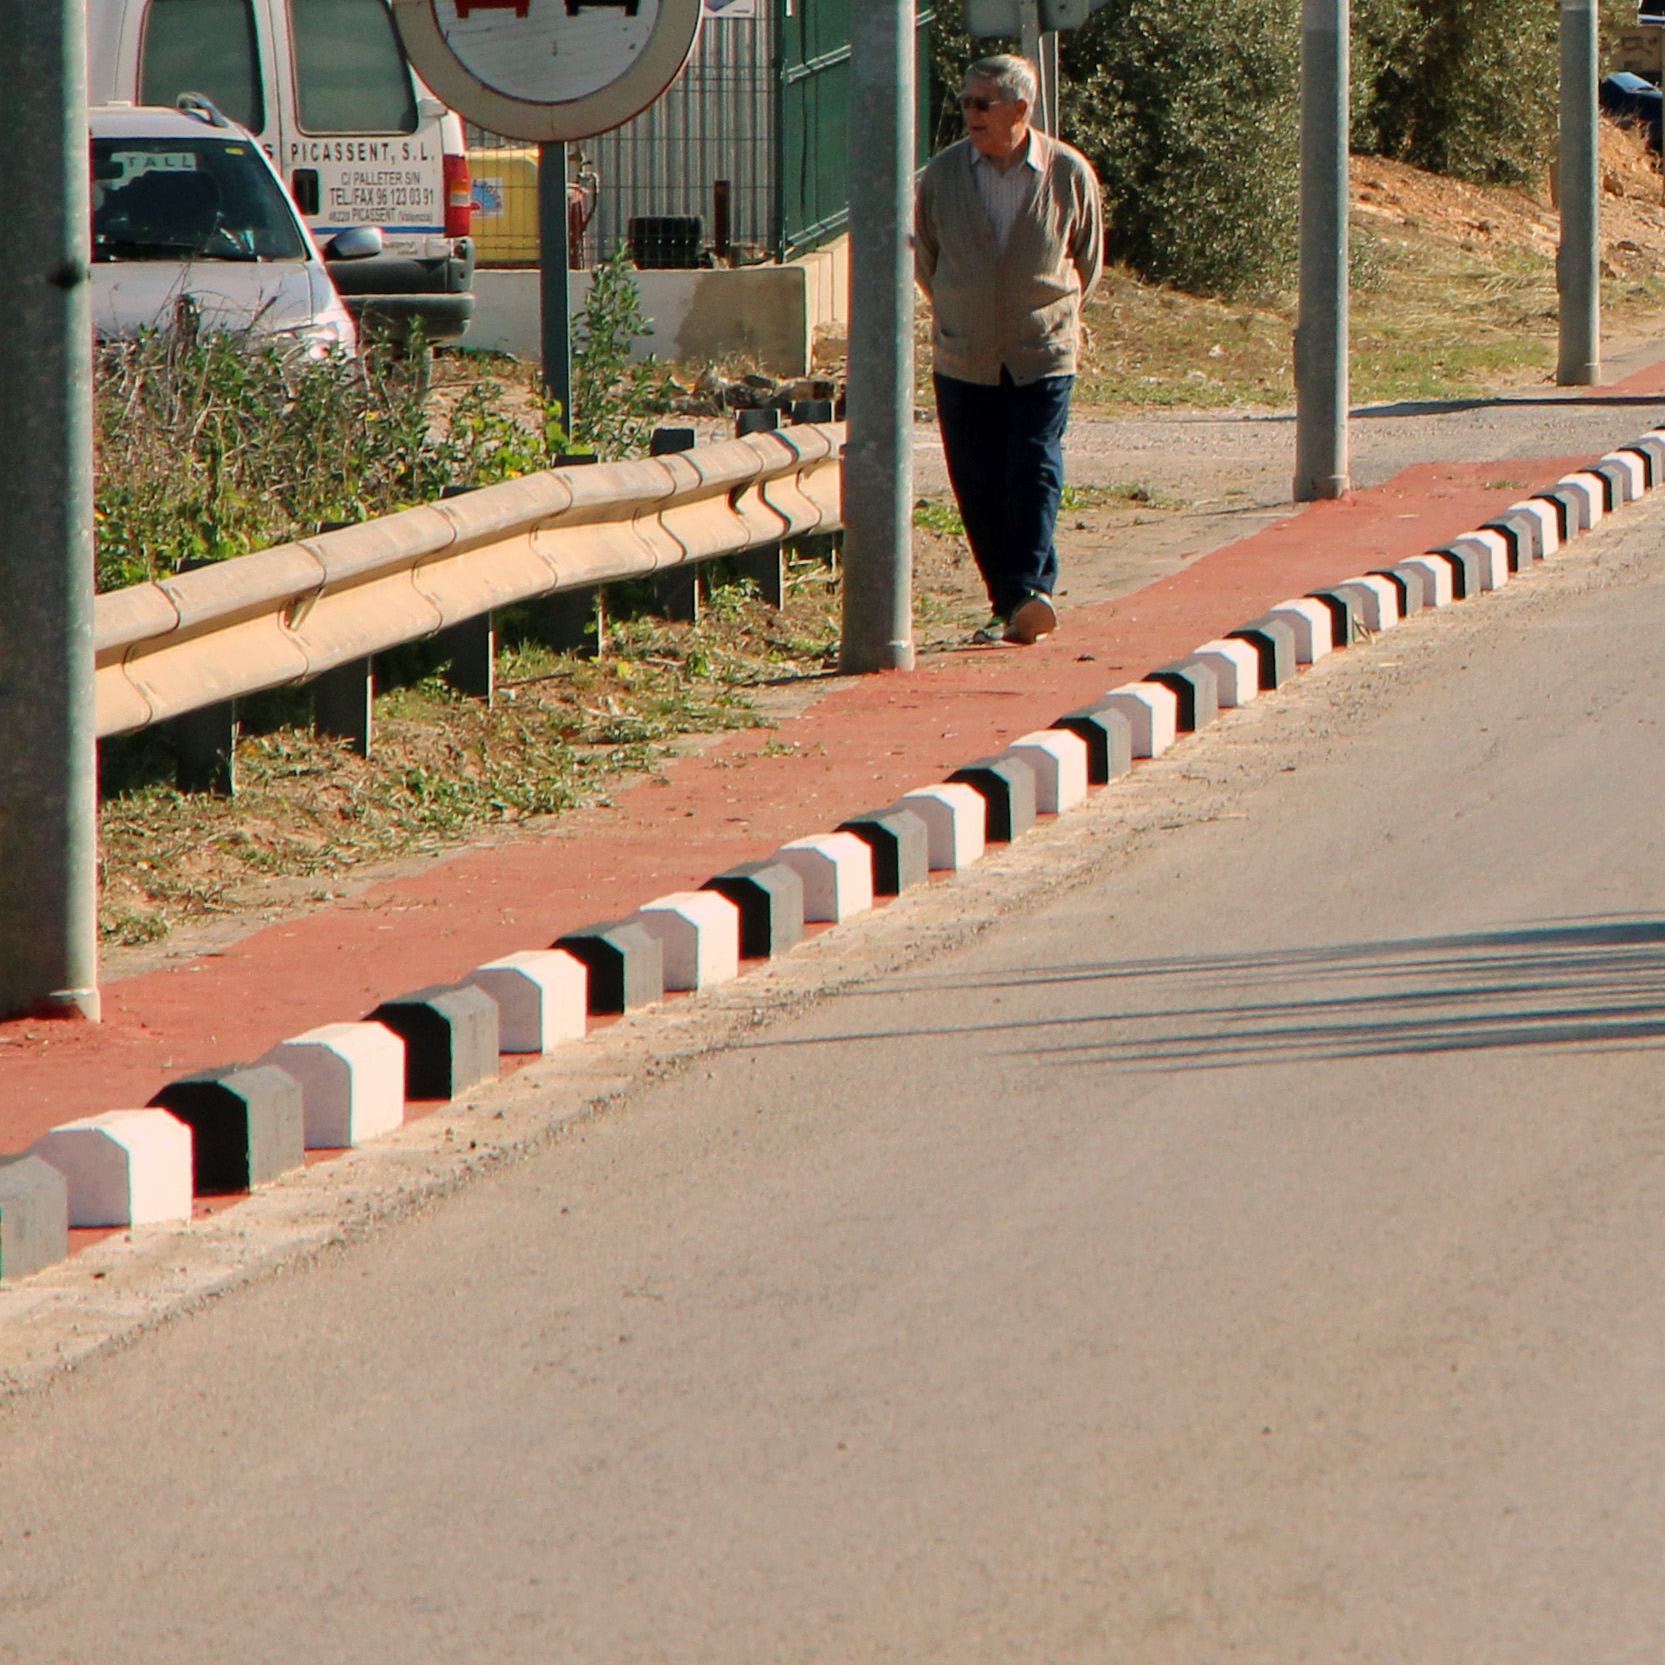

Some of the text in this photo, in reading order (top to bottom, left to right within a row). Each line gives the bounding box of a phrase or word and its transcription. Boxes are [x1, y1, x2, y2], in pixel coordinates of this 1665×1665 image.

[402, 142, 435, 162] S.L.
[353, 171, 403, 186] PALLETER
[408, 187, 422, 206] 03
[423, 187, 434, 206] 91
[351, 207, 396, 222] PICASSENT
